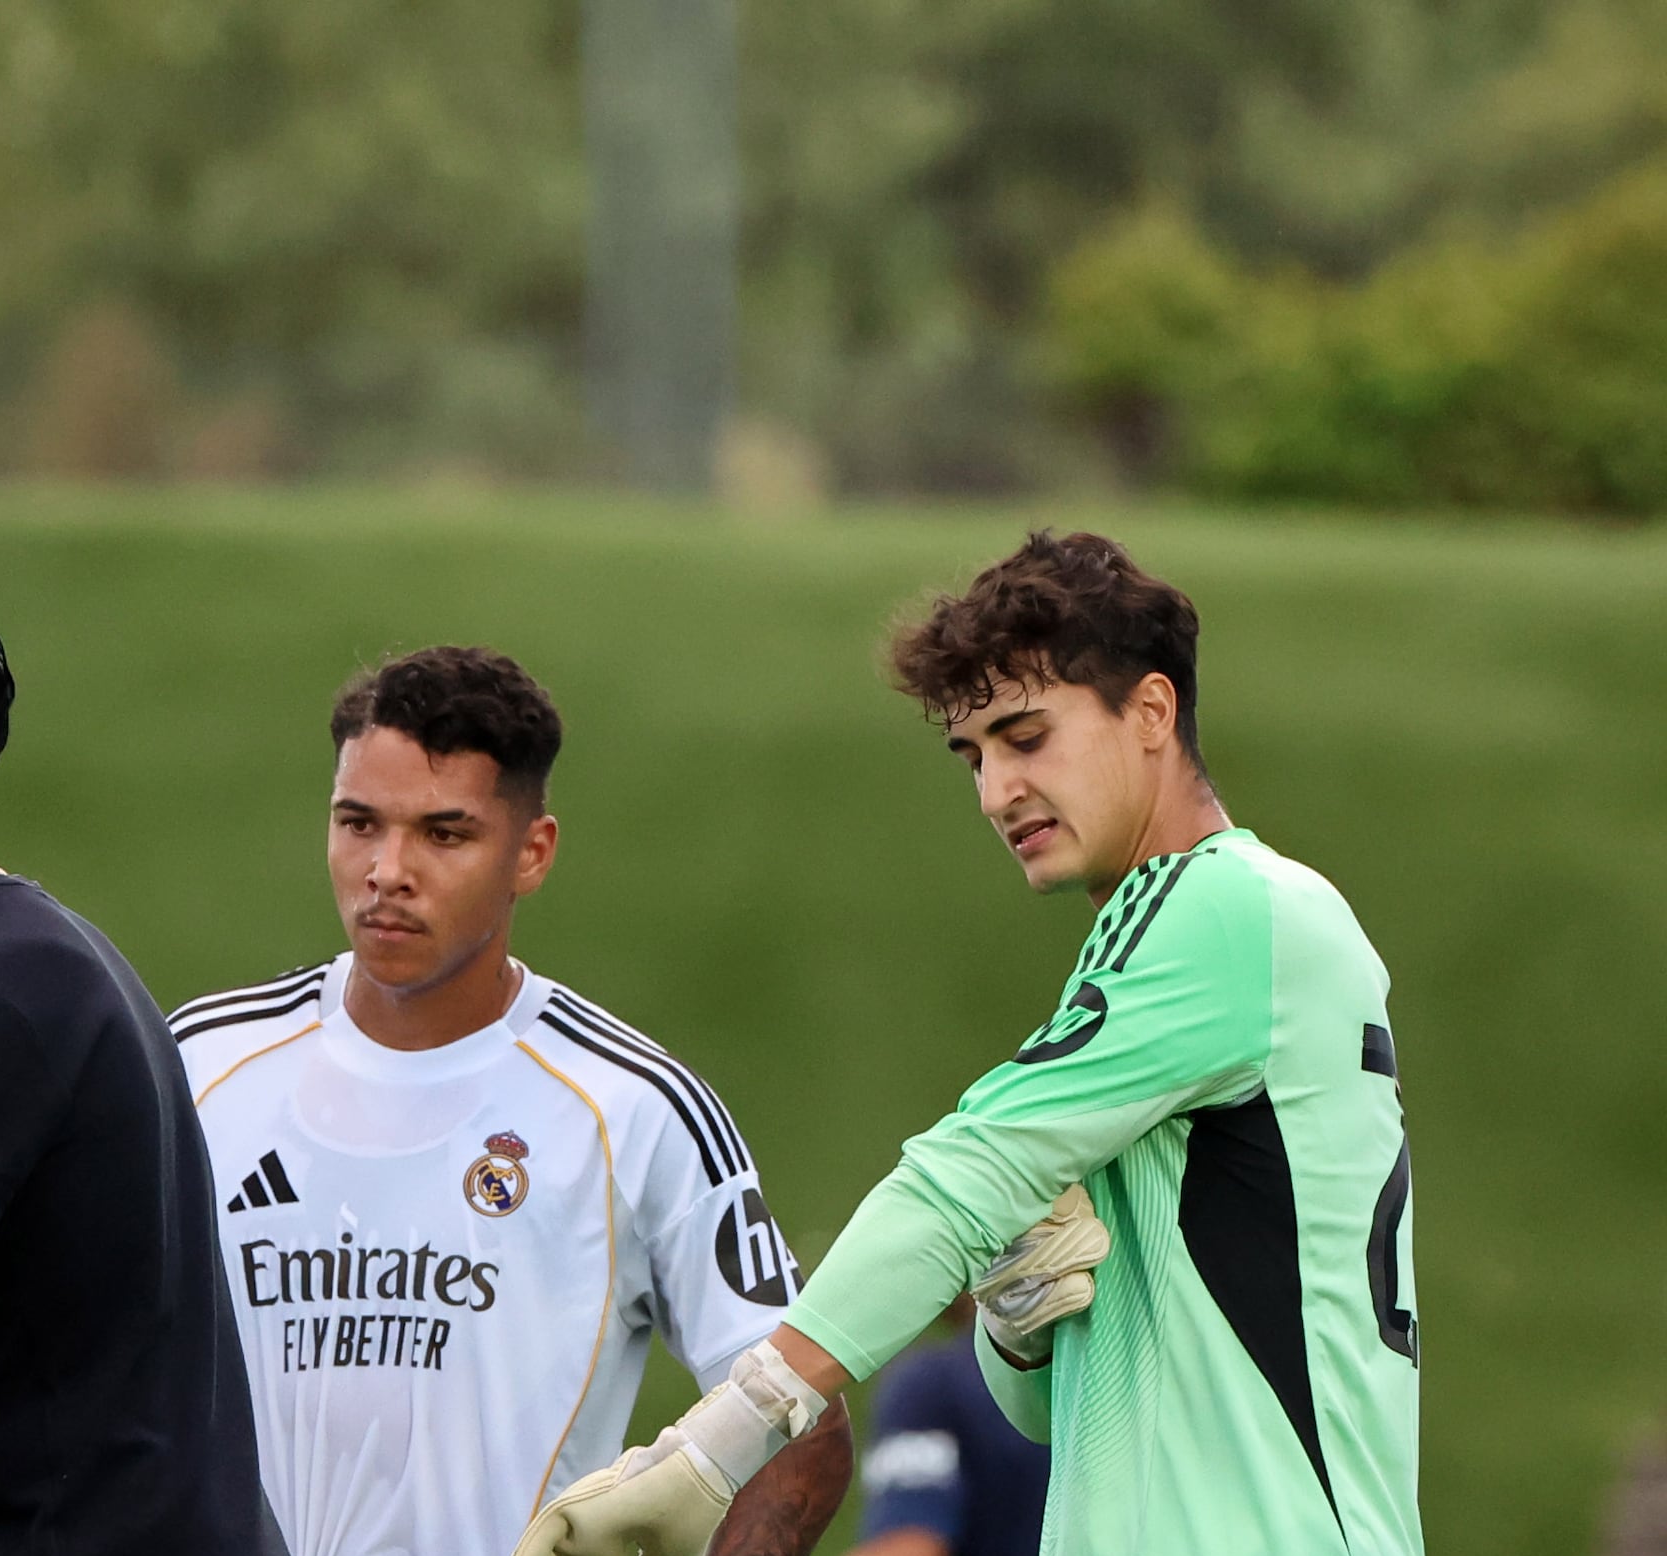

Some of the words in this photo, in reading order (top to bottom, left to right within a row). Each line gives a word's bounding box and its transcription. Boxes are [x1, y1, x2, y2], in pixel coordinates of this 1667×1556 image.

[240, 1231, 499, 1312] Emirates
[283, 1315, 330, 1373] FLY
[333, 1315, 451, 1371] BETTER
